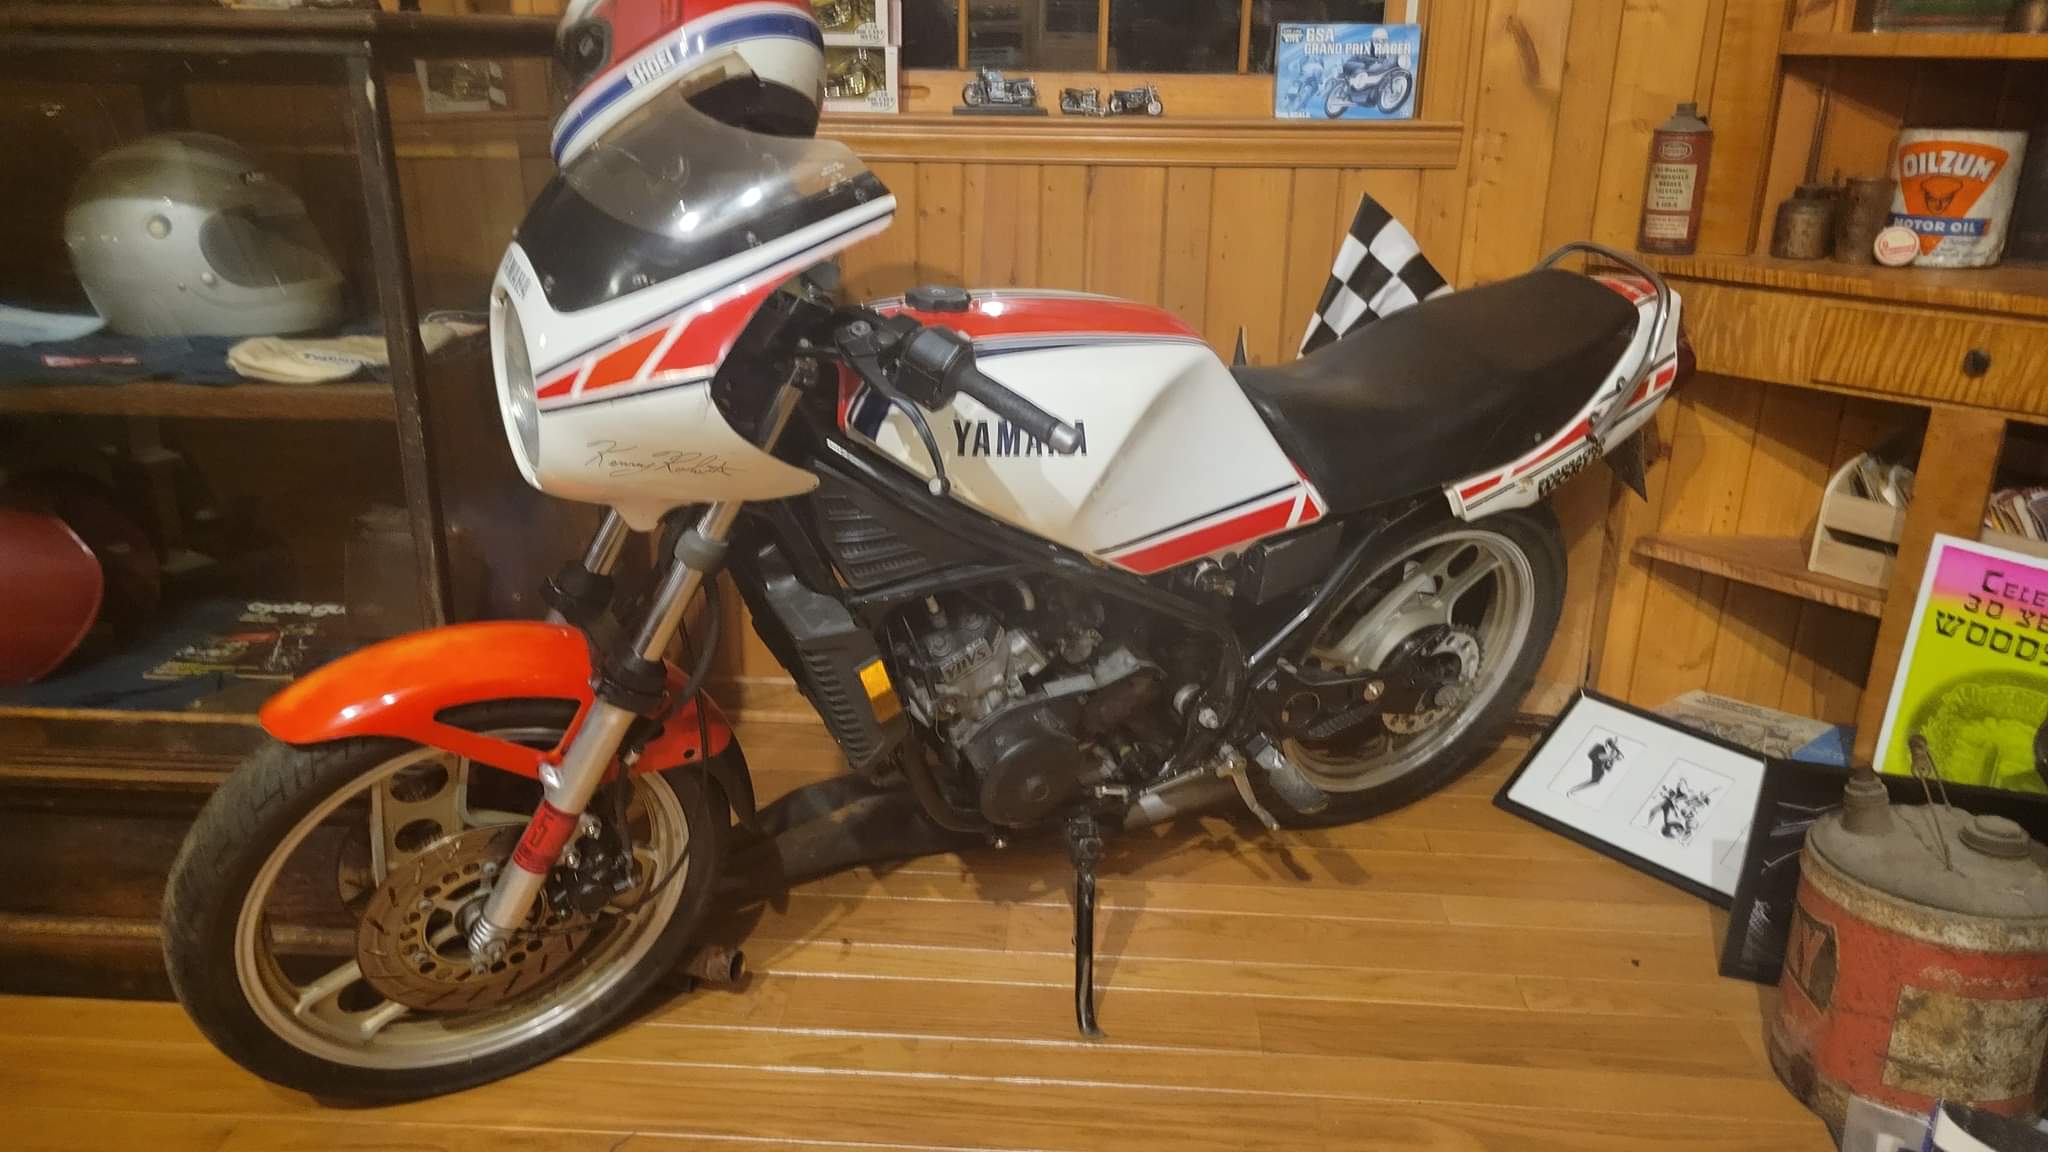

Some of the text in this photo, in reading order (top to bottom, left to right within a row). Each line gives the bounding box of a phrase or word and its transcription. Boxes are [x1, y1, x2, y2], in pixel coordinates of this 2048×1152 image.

[1304, 42, 1411, 56] GRAND PRIX RACER
[626, 47, 677, 88] SHOEI
[1903, 150, 1996, 183] OILZUM
[1894, 217, 1976, 233] MOTOR OIL
[953, 419, 1088, 457] YAMAA
[1964, 592, 2004, 619] 30
